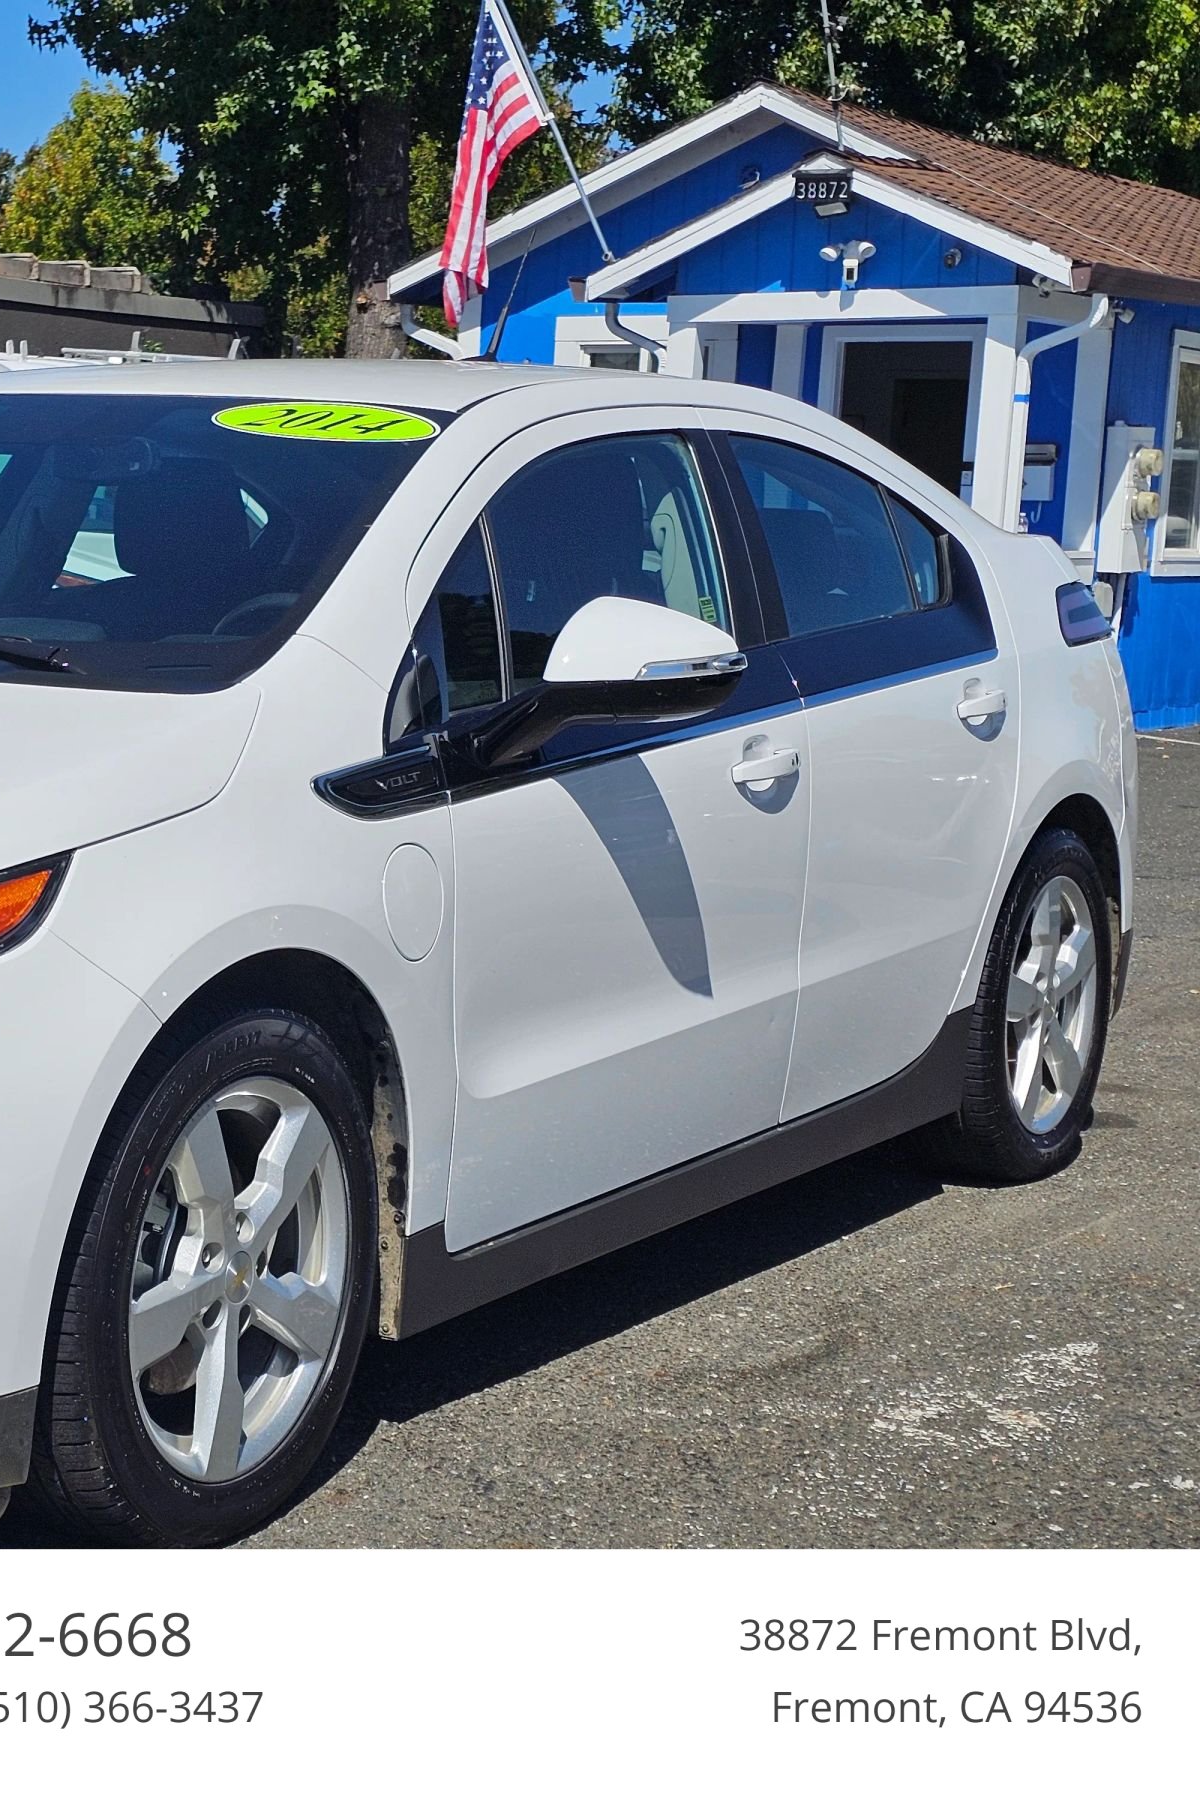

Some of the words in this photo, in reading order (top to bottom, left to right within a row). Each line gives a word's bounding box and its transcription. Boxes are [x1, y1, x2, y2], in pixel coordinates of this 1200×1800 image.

[796, 180, 849, 199] 38872
[236, 408, 411, 435] 2014
[374, 771, 421, 792] VOLT
